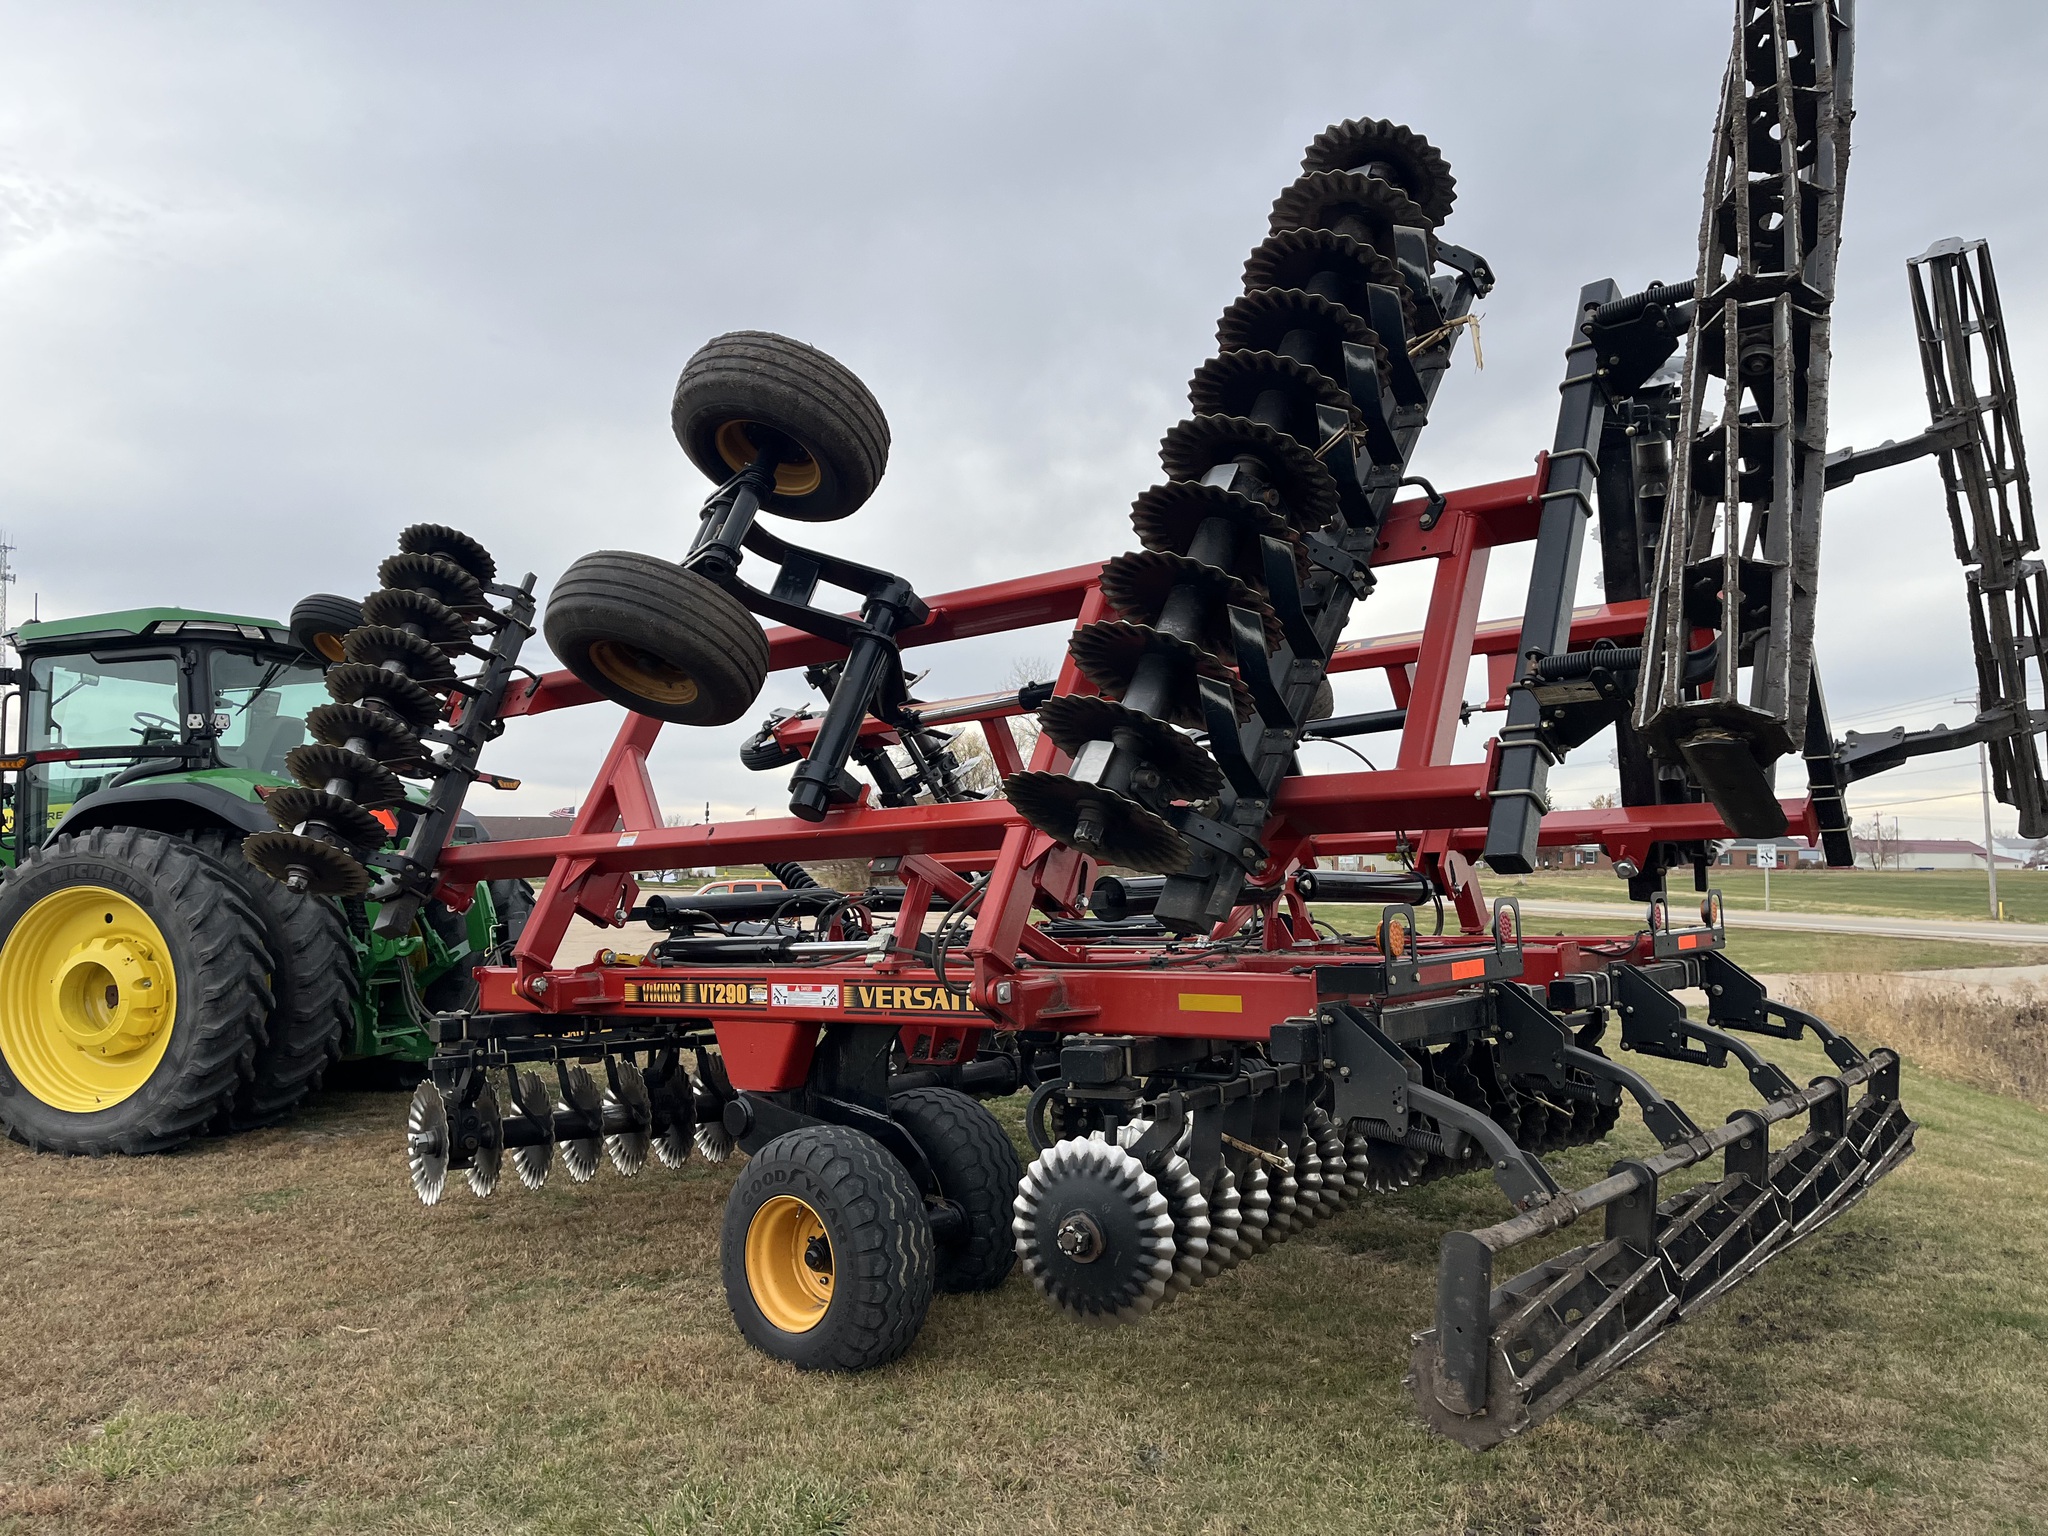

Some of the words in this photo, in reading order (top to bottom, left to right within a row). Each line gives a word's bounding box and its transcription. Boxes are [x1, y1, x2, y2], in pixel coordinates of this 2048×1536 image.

[51, 864, 146, 898] MICHELIN
[642, 983, 681, 1003] VIKING
[699, 983, 747, 1004] VT290
[742, 1168, 848, 1246] GOODYEAR
